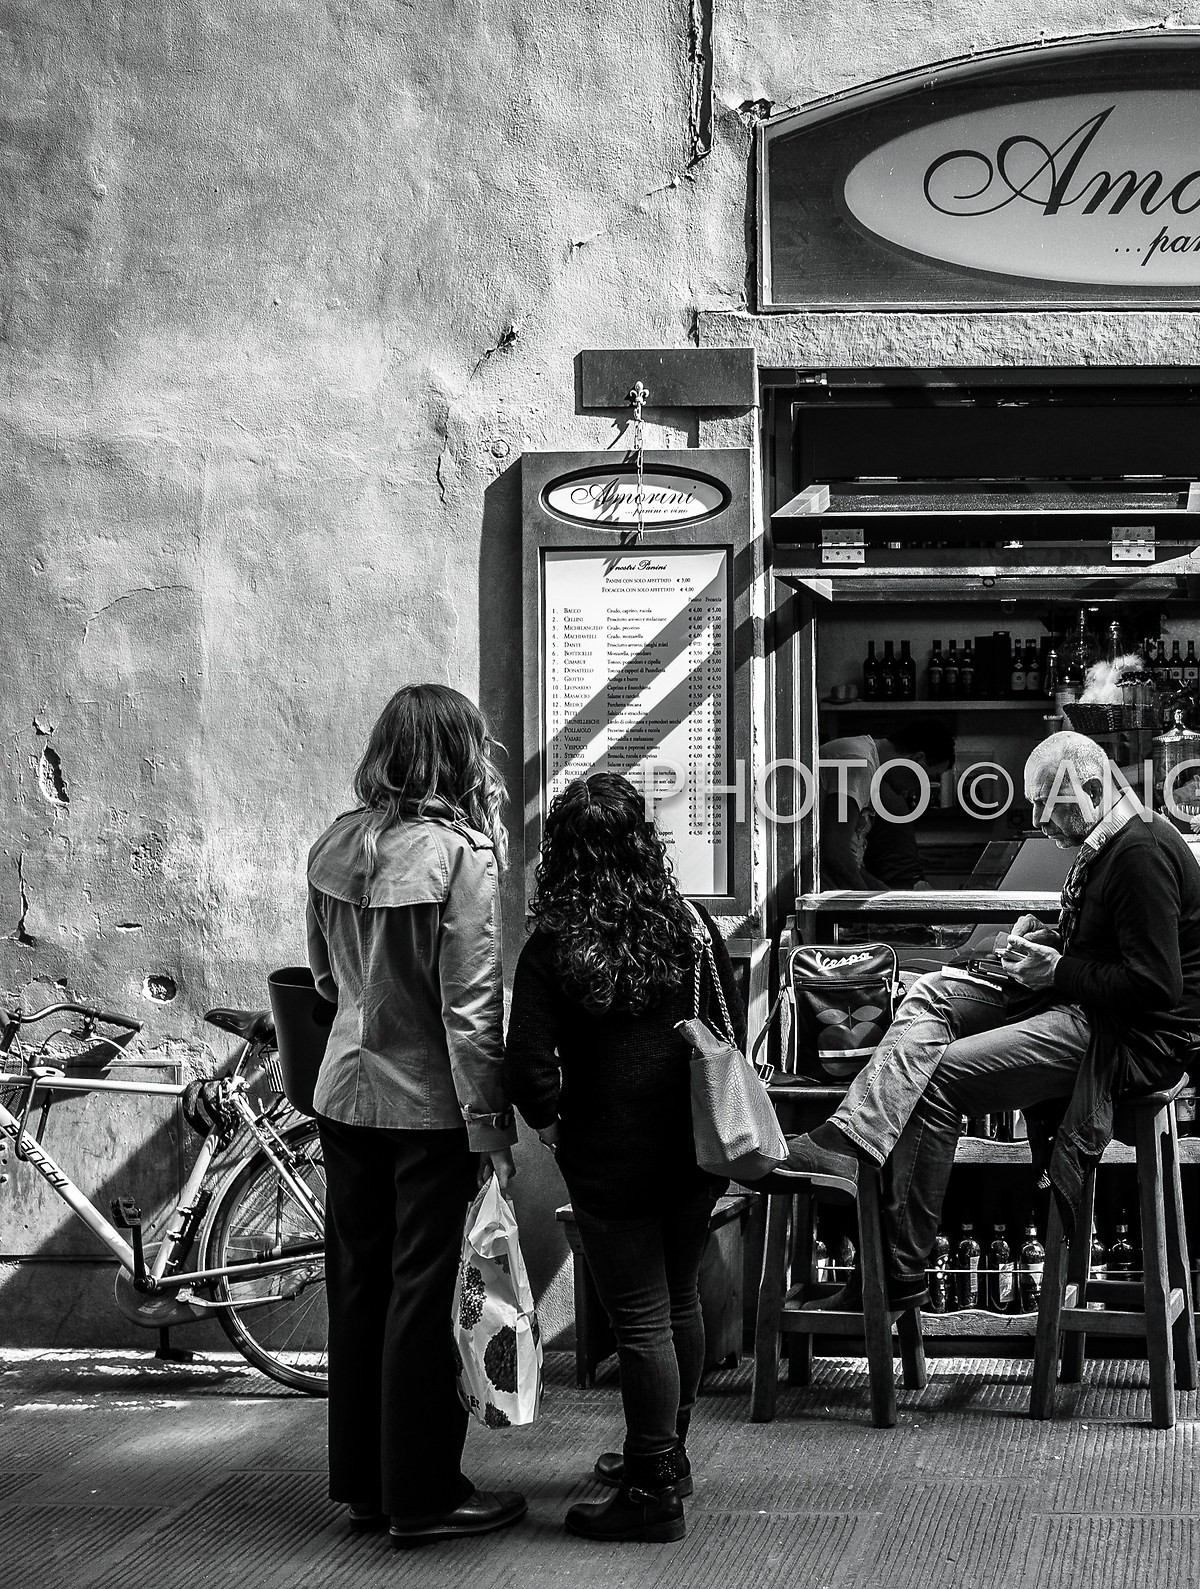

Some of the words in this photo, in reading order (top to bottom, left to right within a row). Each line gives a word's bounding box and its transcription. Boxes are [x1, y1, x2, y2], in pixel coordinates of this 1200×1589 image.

[570, 477, 697, 505] Amorini
[638, 560, 668, 570] Panini
[816, 951, 873, 972] Vespa
[2, 1122, 69, 1189] BANCHI
